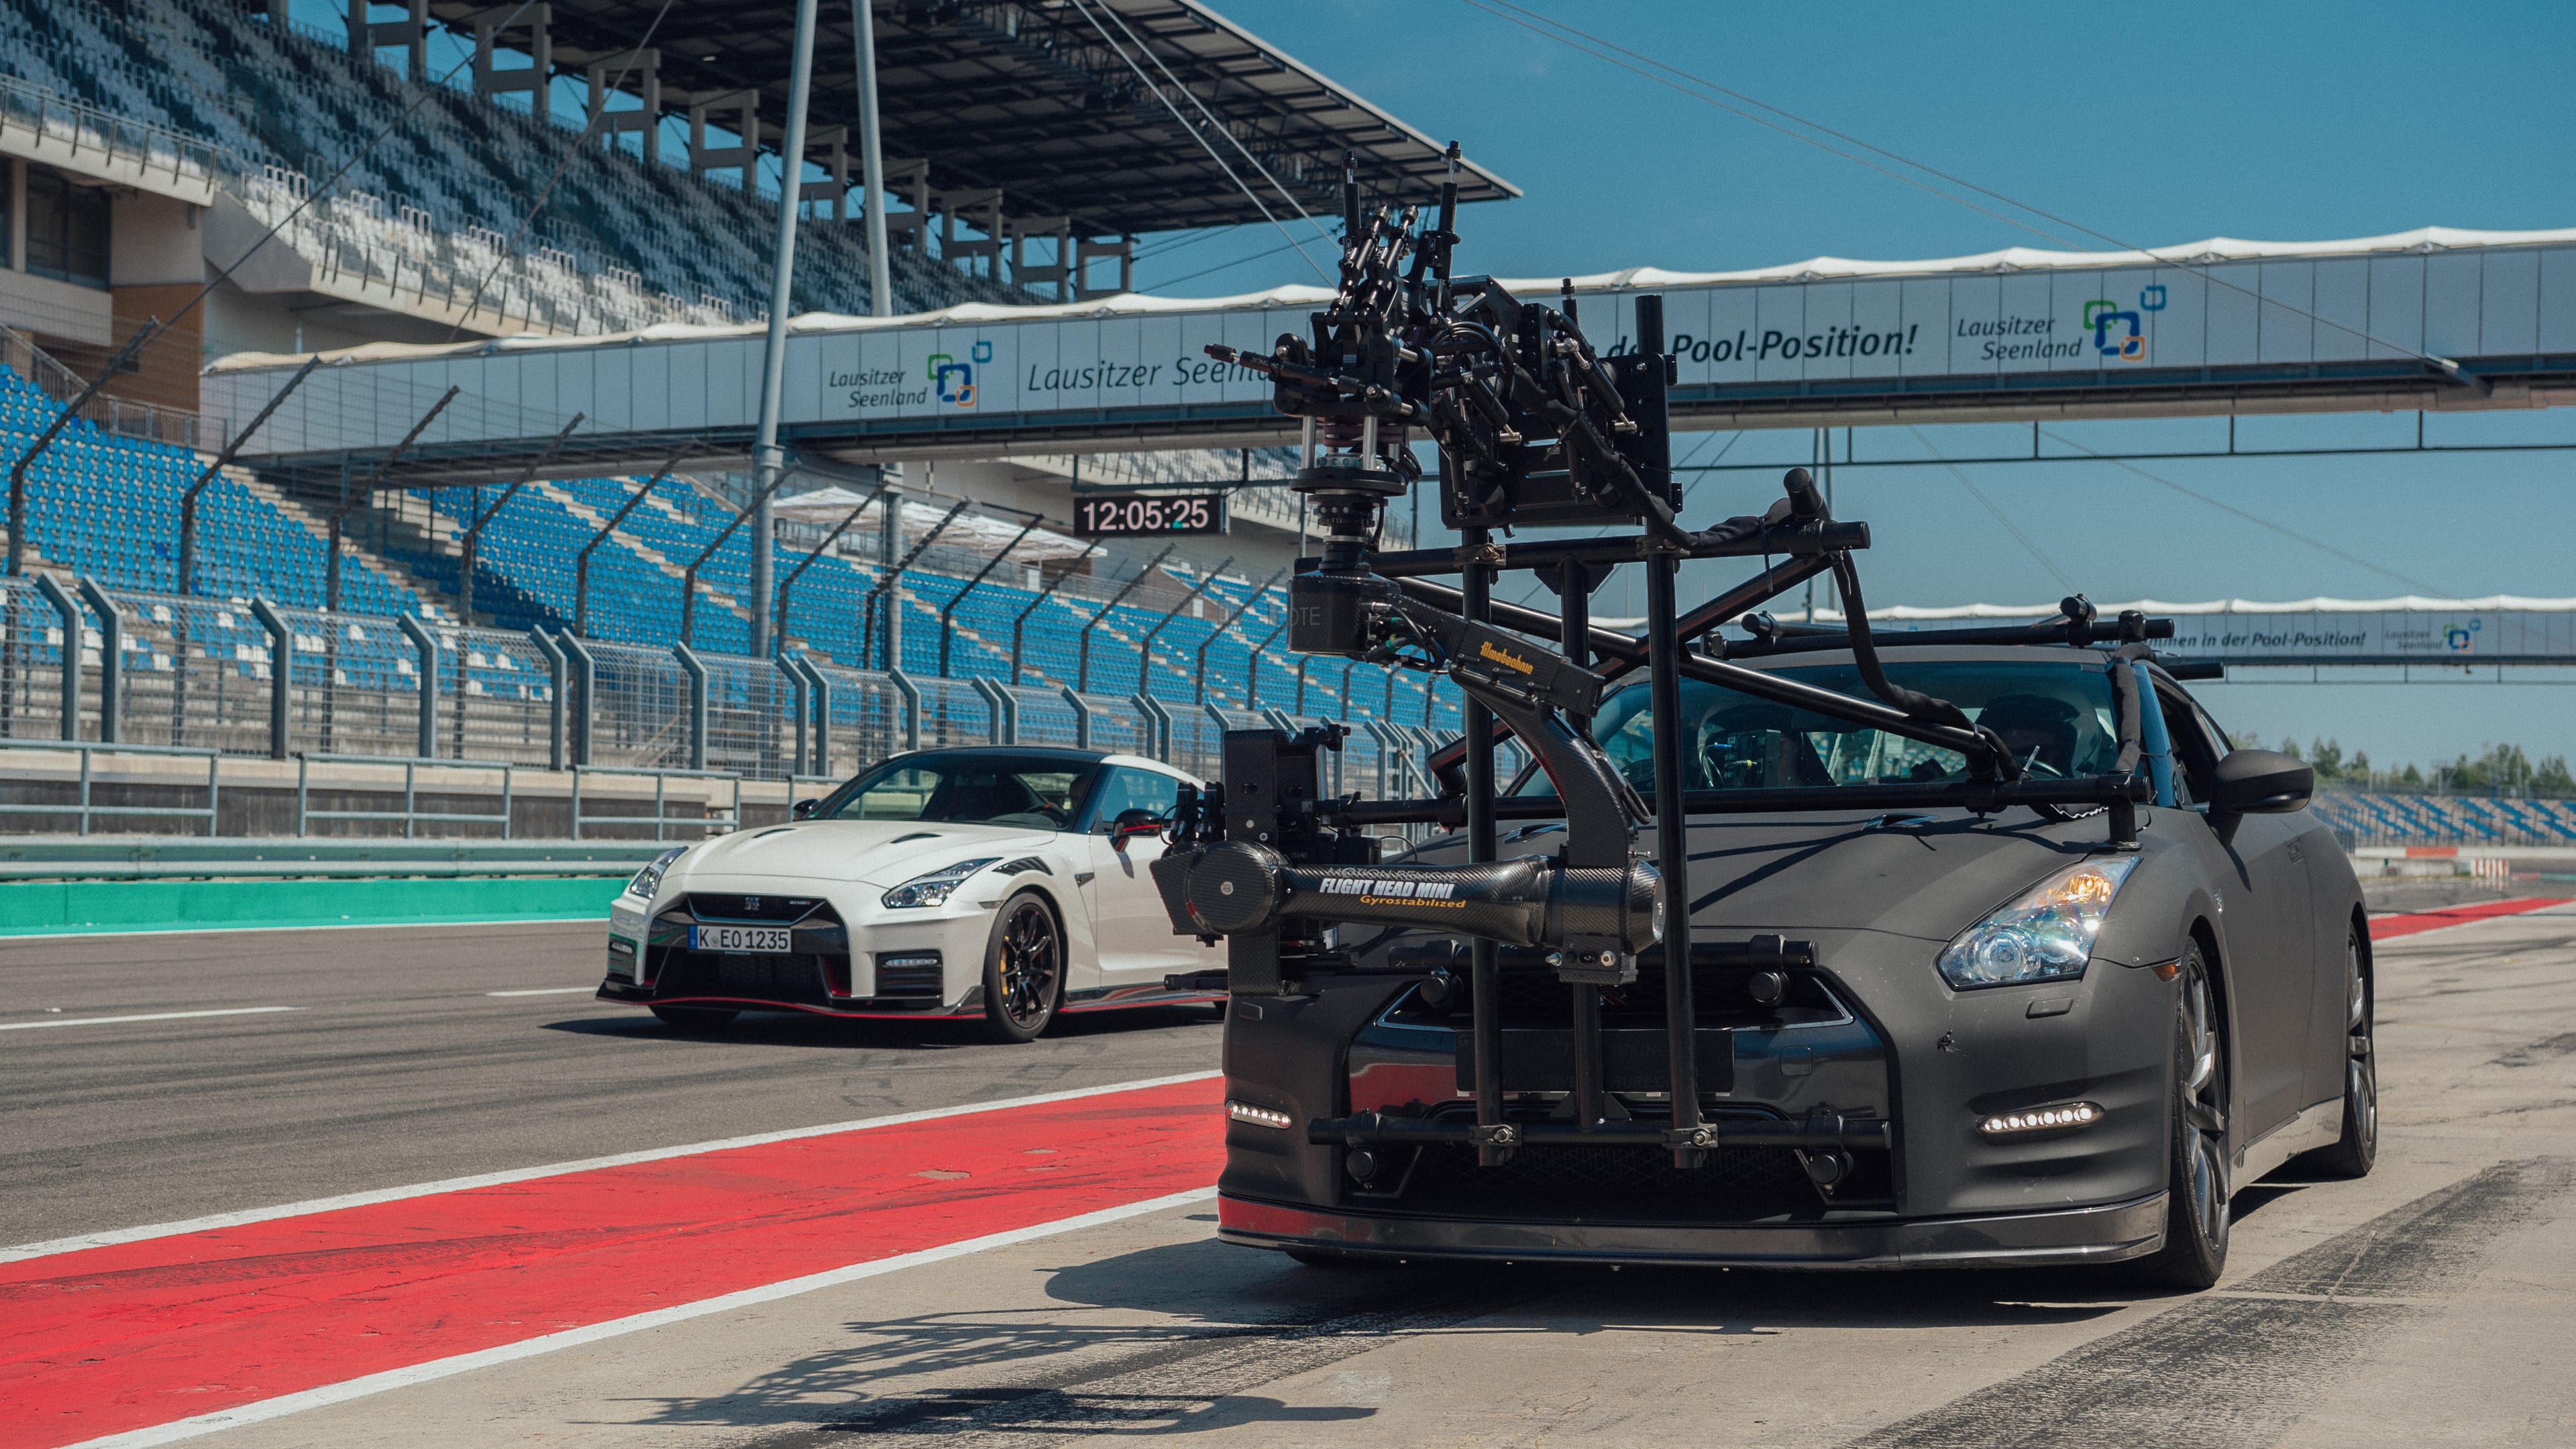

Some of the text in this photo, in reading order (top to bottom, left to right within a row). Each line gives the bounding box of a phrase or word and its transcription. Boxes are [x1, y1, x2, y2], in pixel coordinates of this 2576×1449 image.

[1957, 316, 2055, 337] Lausitzer
[1672, 325, 1918, 363] Pool-Position!
[1981, 337, 2083, 360] Seenland
[829, 368, 907, 388] Lausitzer
[1028, 360, 1163, 391] Lausitzer
[848, 387, 928, 409] Seenland
[1083, 499, 1209, 531] 12:05:25
[2202, 632, 2216, 647] in
[2221, 631, 2247, 647] der
[1319, 877, 1455, 899] FLIGHT HEAD MINI
[1360, 894, 1467, 908] Gyrostabilized
[699, 928, 709, 947] K
[745, 931, 789, 949] 1235
